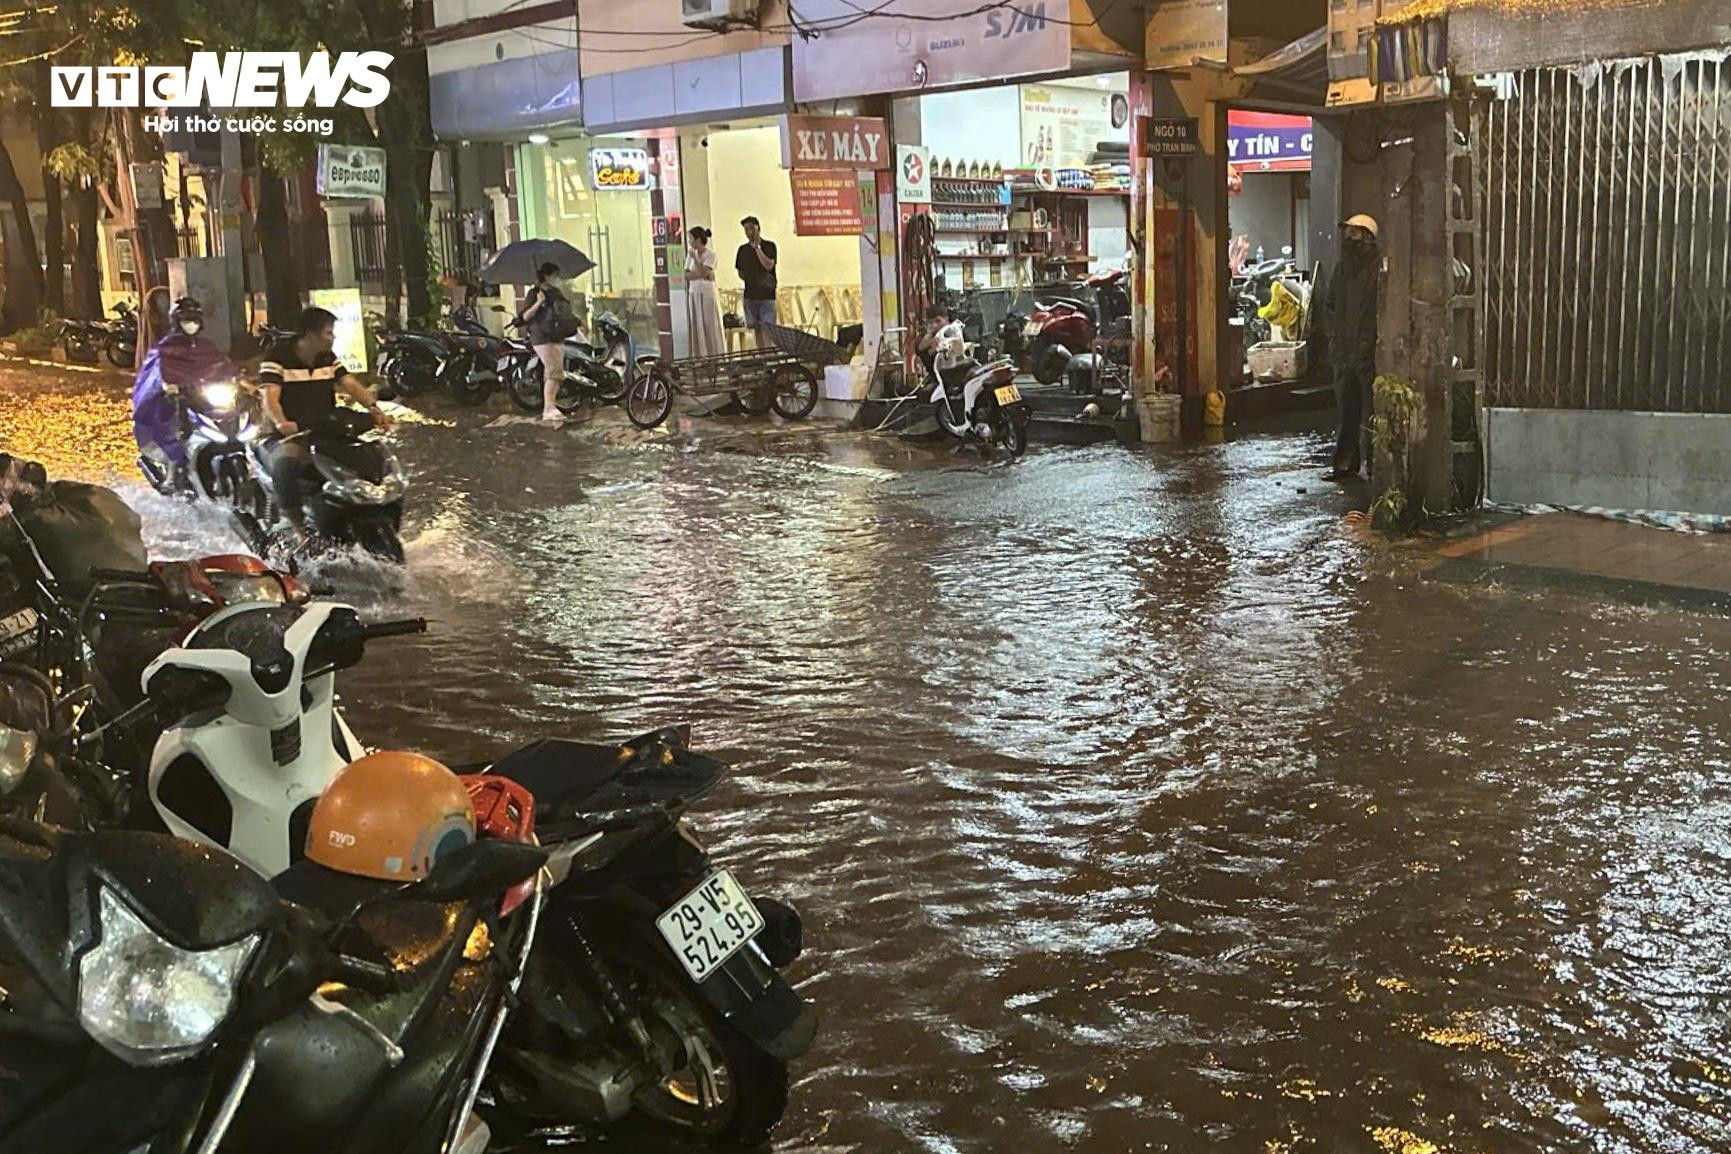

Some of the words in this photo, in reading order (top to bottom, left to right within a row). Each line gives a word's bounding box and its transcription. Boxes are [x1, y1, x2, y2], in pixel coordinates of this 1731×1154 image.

[984, 3, 1045, 38] SYM
[797, 130, 828, 160] XE
[832, 125, 880, 162] MÁY
[1177, 125, 1187, 138] 10
[1245, 133, 1279, 155] TÍN
[331, 165, 380, 184] espresso
[671, 878, 731, 942] 29-V5
[683, 902, 756, 973] 524.95
